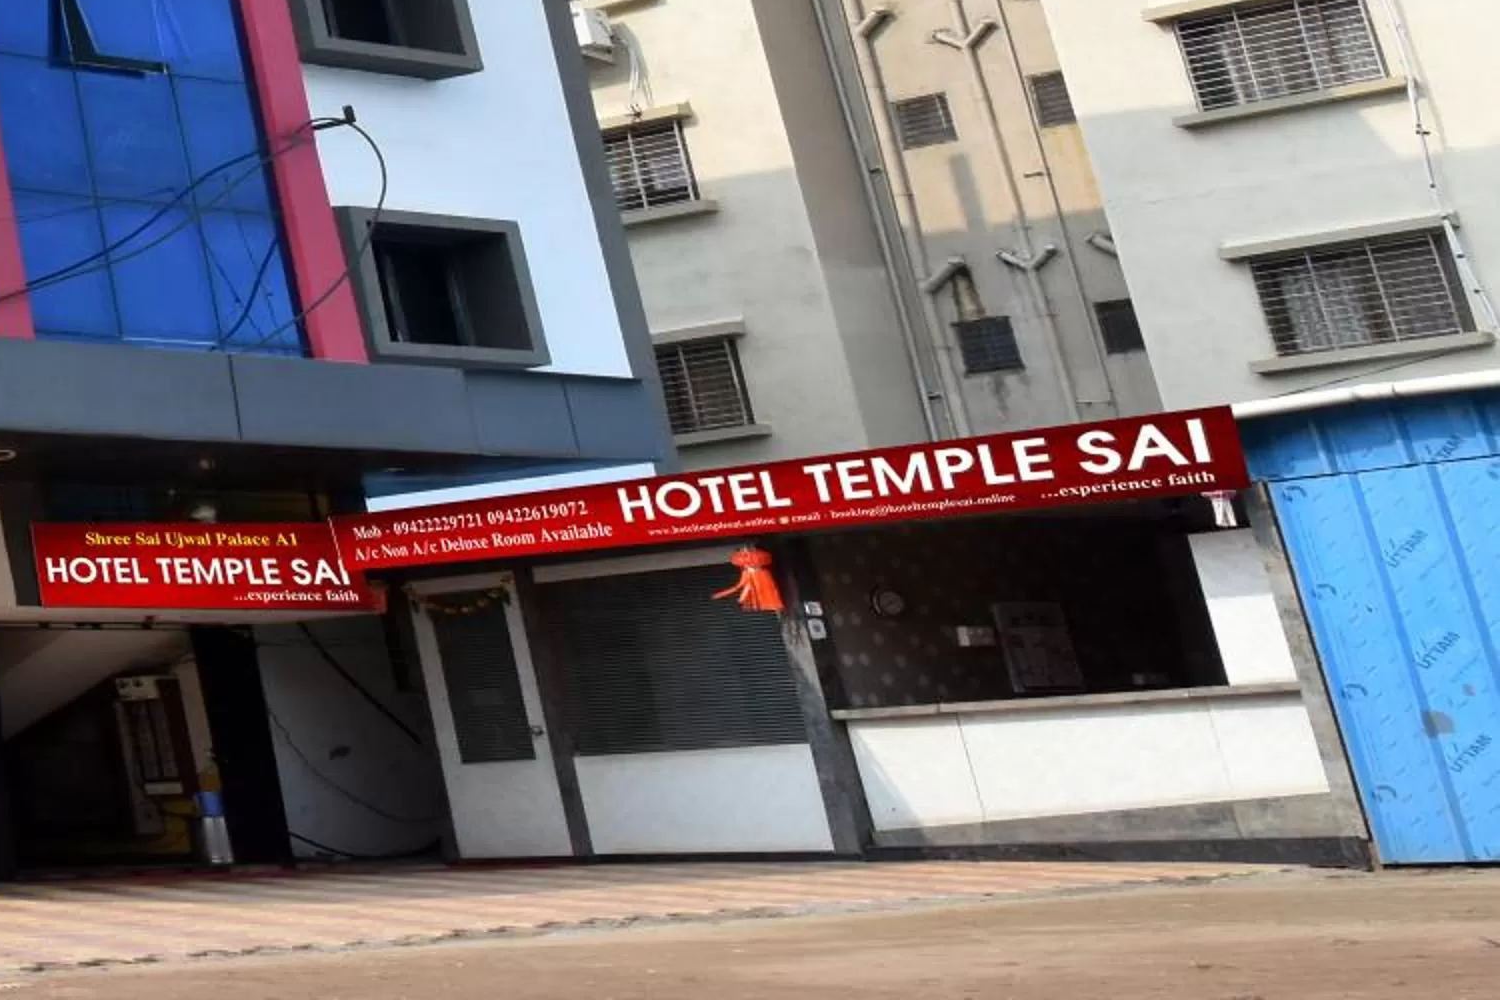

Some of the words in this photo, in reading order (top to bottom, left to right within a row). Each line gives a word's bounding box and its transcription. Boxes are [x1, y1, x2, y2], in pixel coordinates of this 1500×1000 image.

[617, 470, 793, 524] HOTEL
[803, 437, 1055, 503] TEMPLE
[1076, 418, 1214, 475] SAI
[1167, 471, 1216, 487] faith
[85, 531, 131, 547] Shree
[135, 531, 160, 547] Sai
[165, 532, 211, 548] Ujwal
[216, 533, 271, 547] Palace
[492, 529, 535, 547] Room
[540, 522, 613, 543] Available
[45, 557, 149, 584] HOTEL
[156, 557, 283, 585] TEMPLE
[291, 558, 351, 586] SAI
[326, 589, 359, 602] faith
